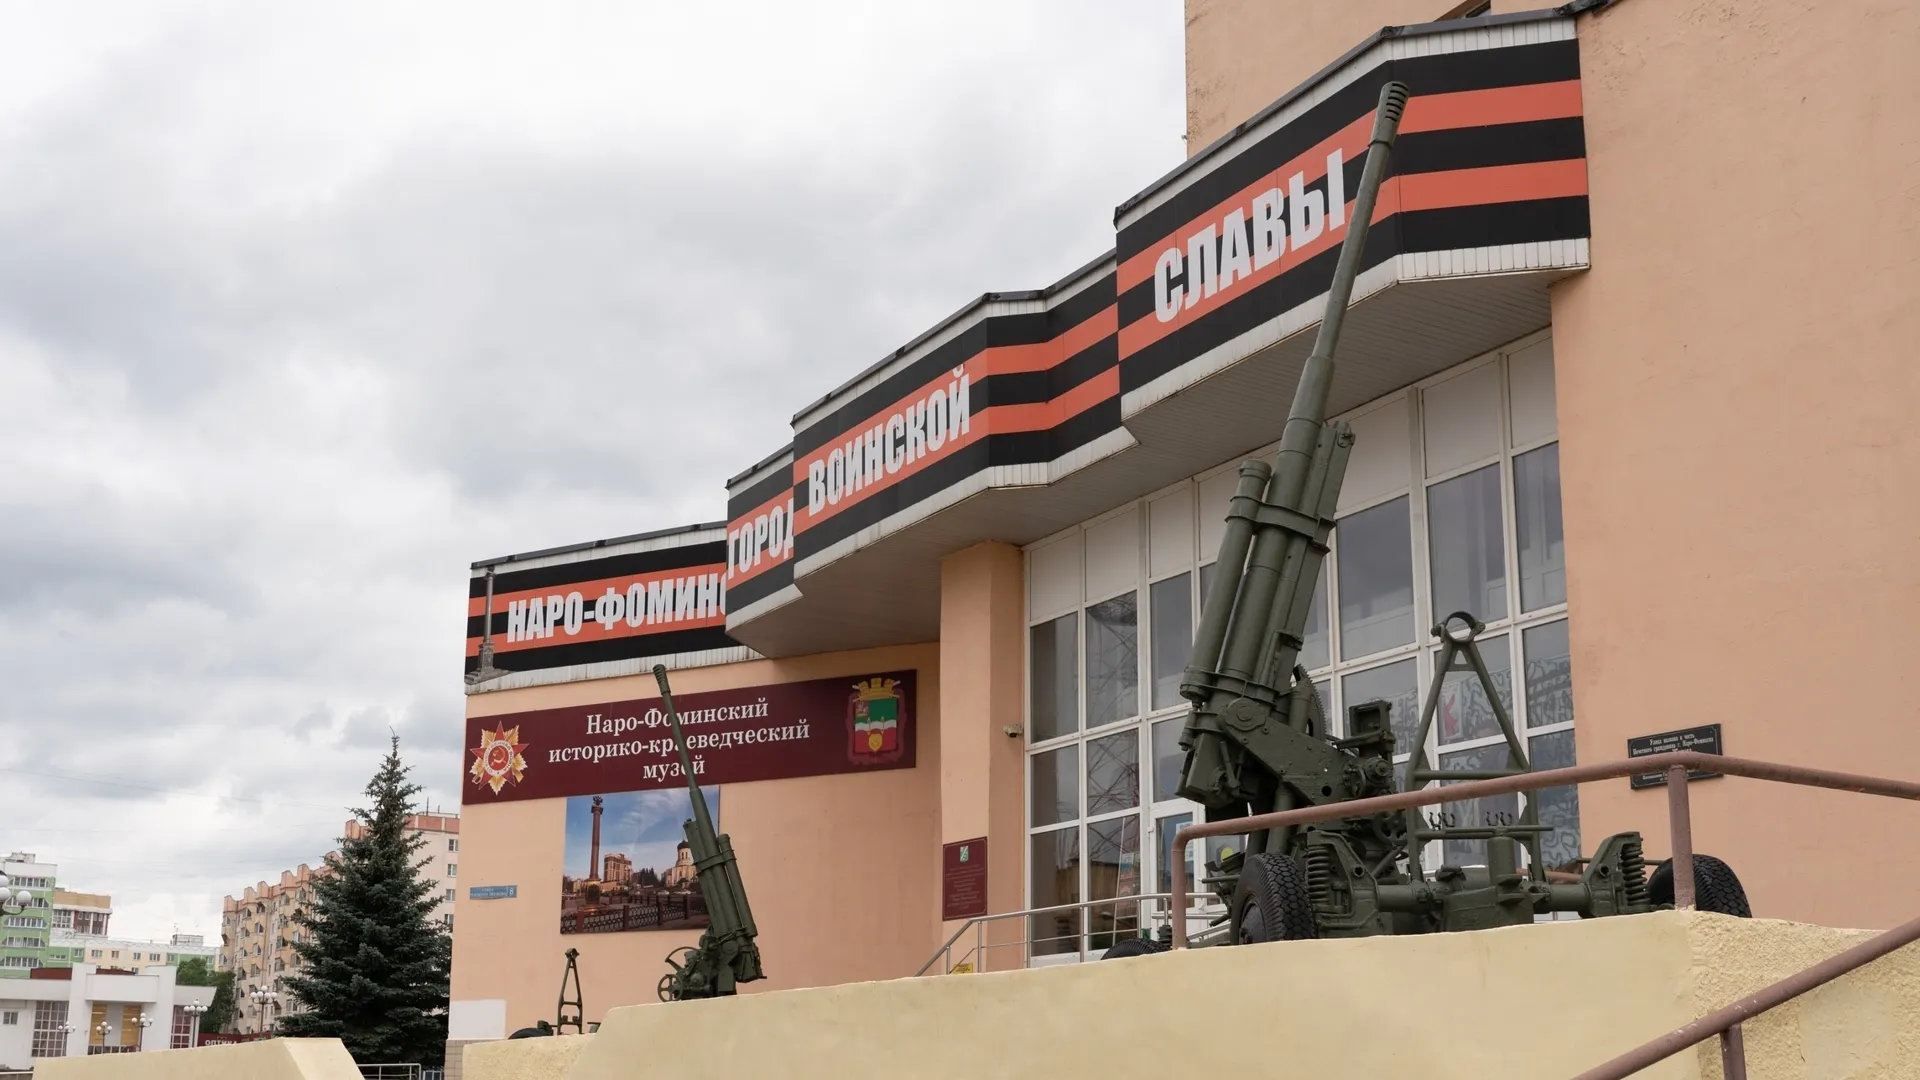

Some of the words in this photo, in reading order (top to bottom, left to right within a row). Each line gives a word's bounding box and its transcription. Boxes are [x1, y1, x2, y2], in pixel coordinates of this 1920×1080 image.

[808, 363, 970, 517] ВОИНСКОЙ
[1154, 148, 1346, 323] СЛАВЫ
[509, 887, 514, 895] 8
